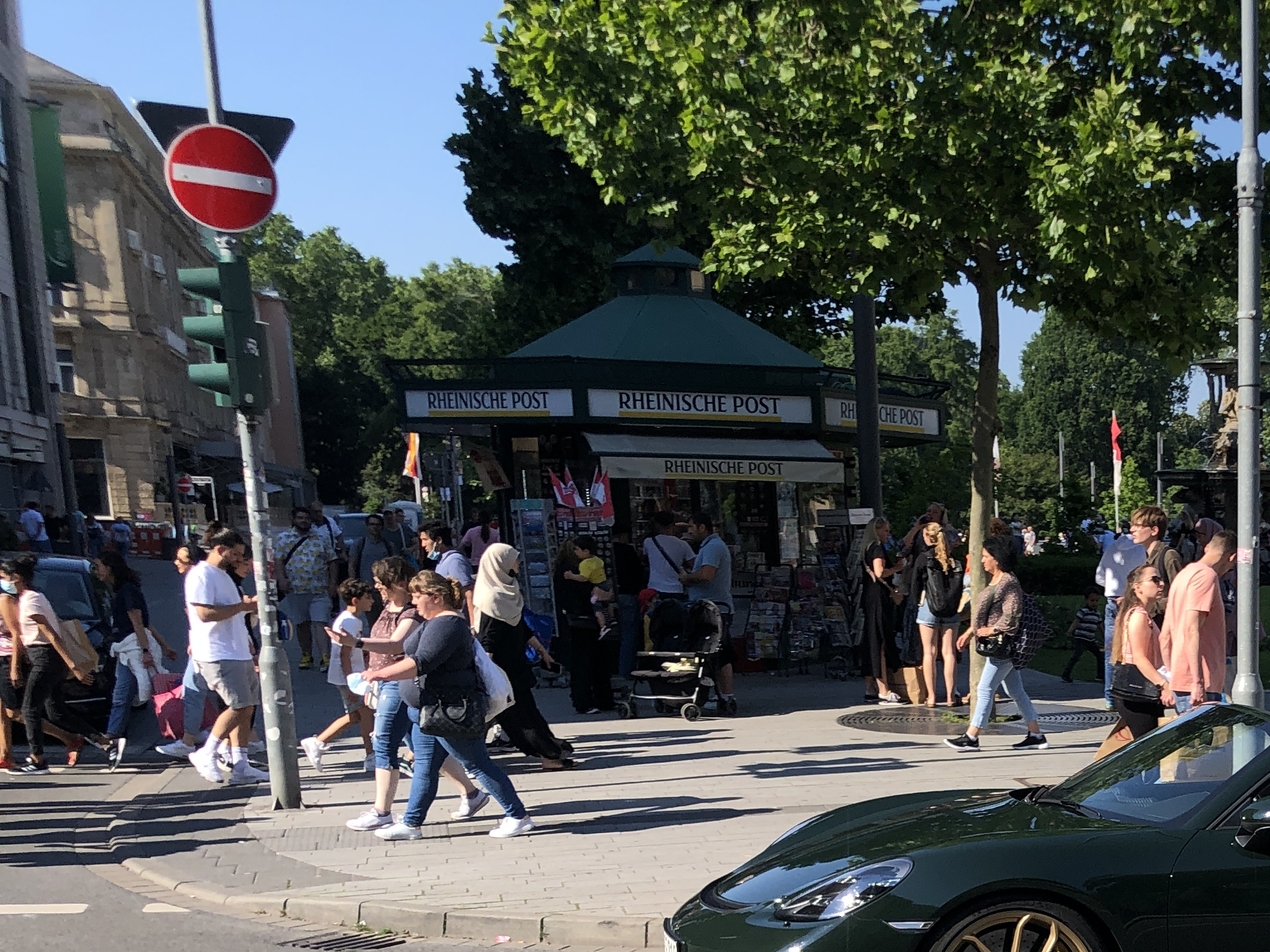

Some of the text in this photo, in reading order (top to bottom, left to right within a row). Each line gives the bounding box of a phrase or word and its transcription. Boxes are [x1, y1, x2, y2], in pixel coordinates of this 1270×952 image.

[427, 391, 549, 410] RHEINISCHE POST
[618, 391, 781, 415] RHEINISCHE POST
[840, 401, 925, 427] RHCHE POST
[664, 459, 784, 476] RHEINISCHE POST
